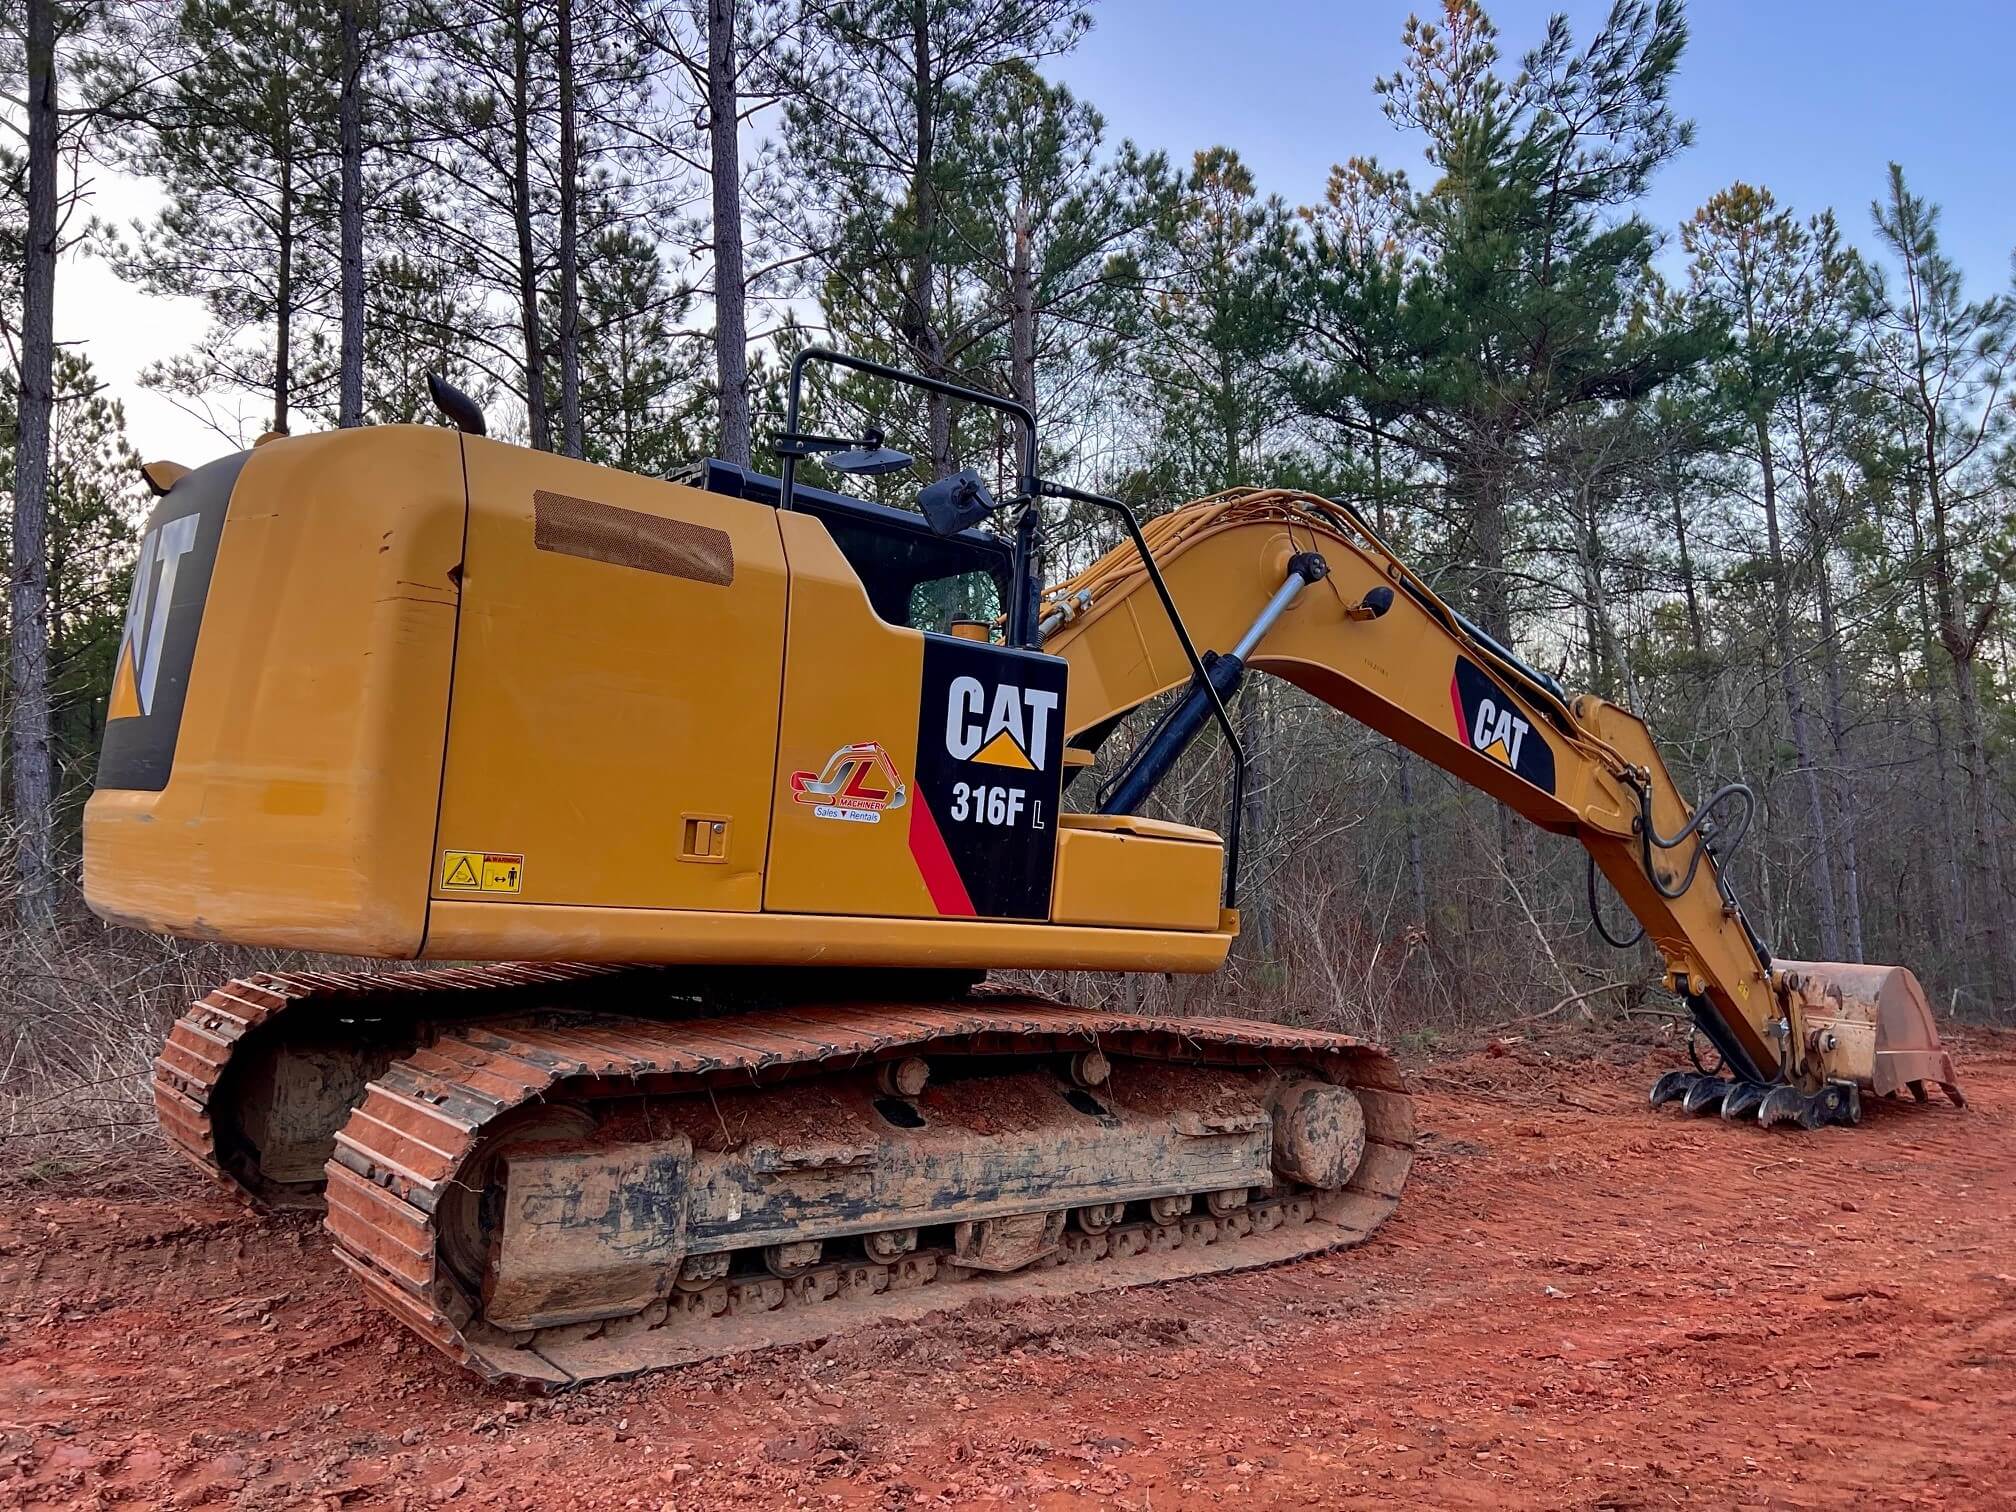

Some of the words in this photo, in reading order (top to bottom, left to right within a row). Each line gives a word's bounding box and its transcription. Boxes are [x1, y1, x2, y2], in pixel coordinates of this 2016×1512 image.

[109, 513, 200, 716] AT
[946, 676, 1058, 771] CAT
[1474, 699, 1528, 769] CAT
[816, 807, 838, 818] Sales
[849, 810, 878, 822] Rentals
[839, 799, 885, 811] MACHINERY
[951, 782, 1026, 826] 316F
[1032, 800, 1045, 829] L
